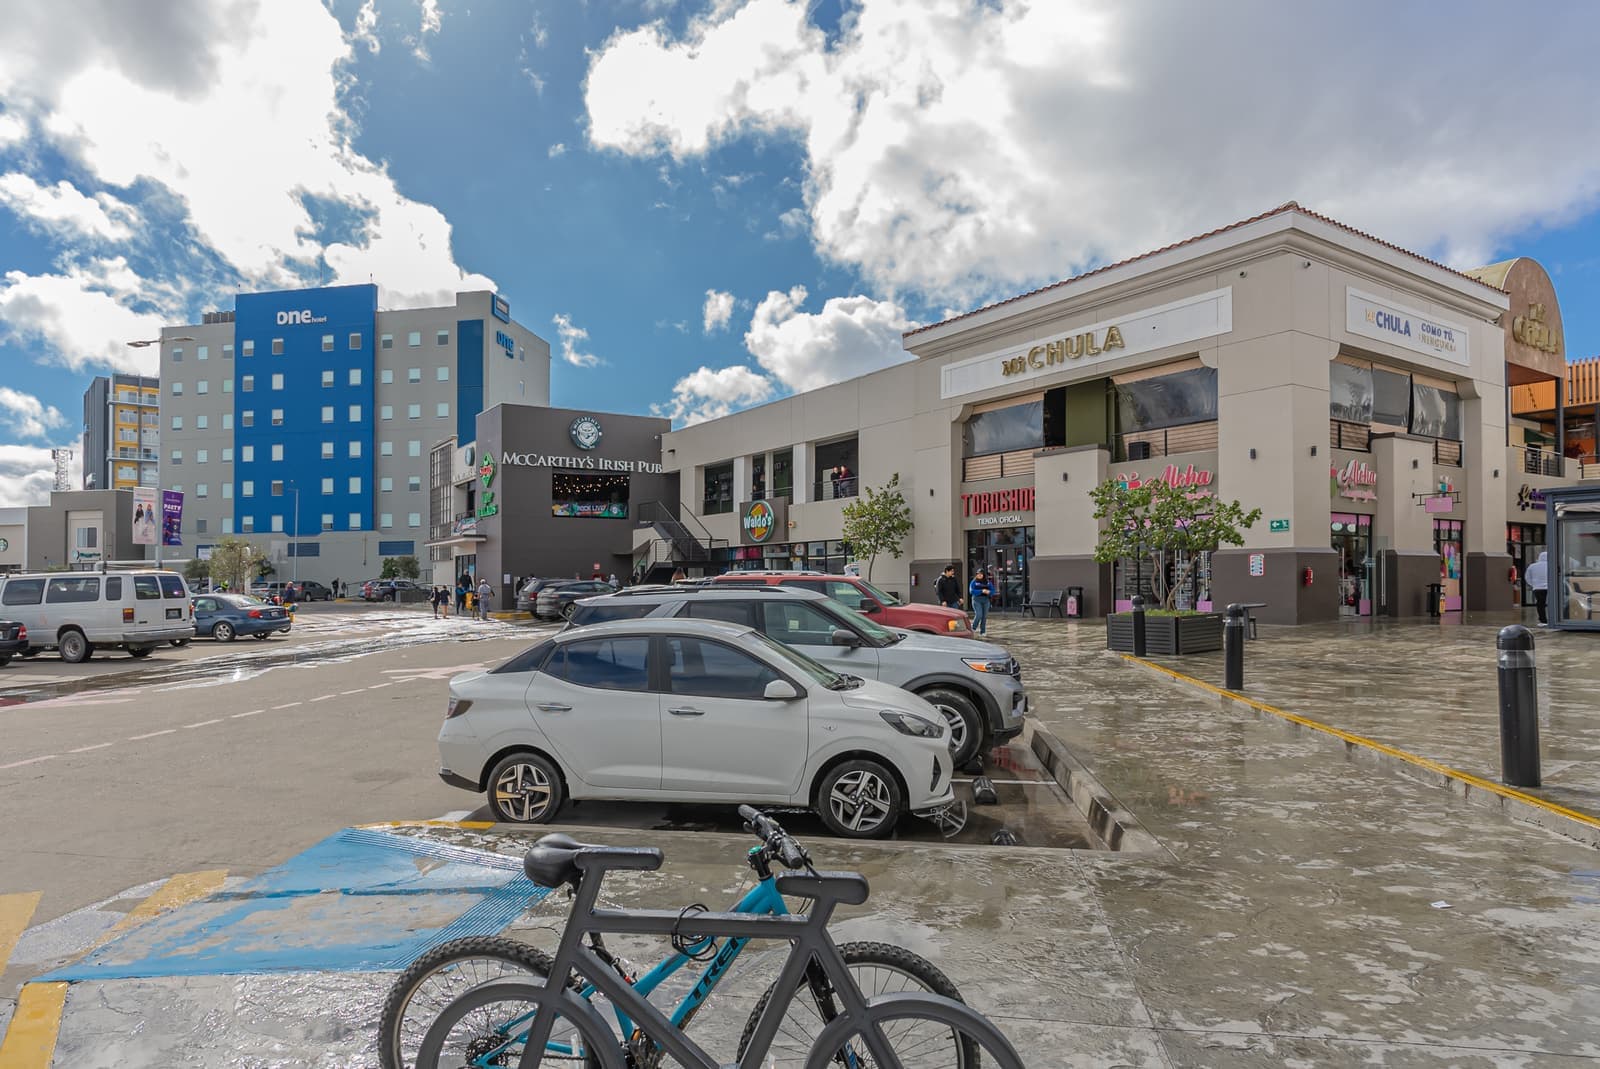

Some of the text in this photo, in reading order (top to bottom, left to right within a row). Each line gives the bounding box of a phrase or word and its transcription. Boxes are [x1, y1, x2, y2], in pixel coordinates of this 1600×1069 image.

[276, 309, 311, 325] one
[1376, 311, 1411, 337] CHULA
[1421, 322, 1442, 337] COMO
[1028, 326, 1125, 369] CHULA
[599, 458, 634, 472] IRISH
[637, 461, 662, 474] PUB
[743, 512, 773, 529] Waldo's
[978, 514, 1022, 526] TIENDA OFICIAL
[687, 936, 745, 1002] TRE
